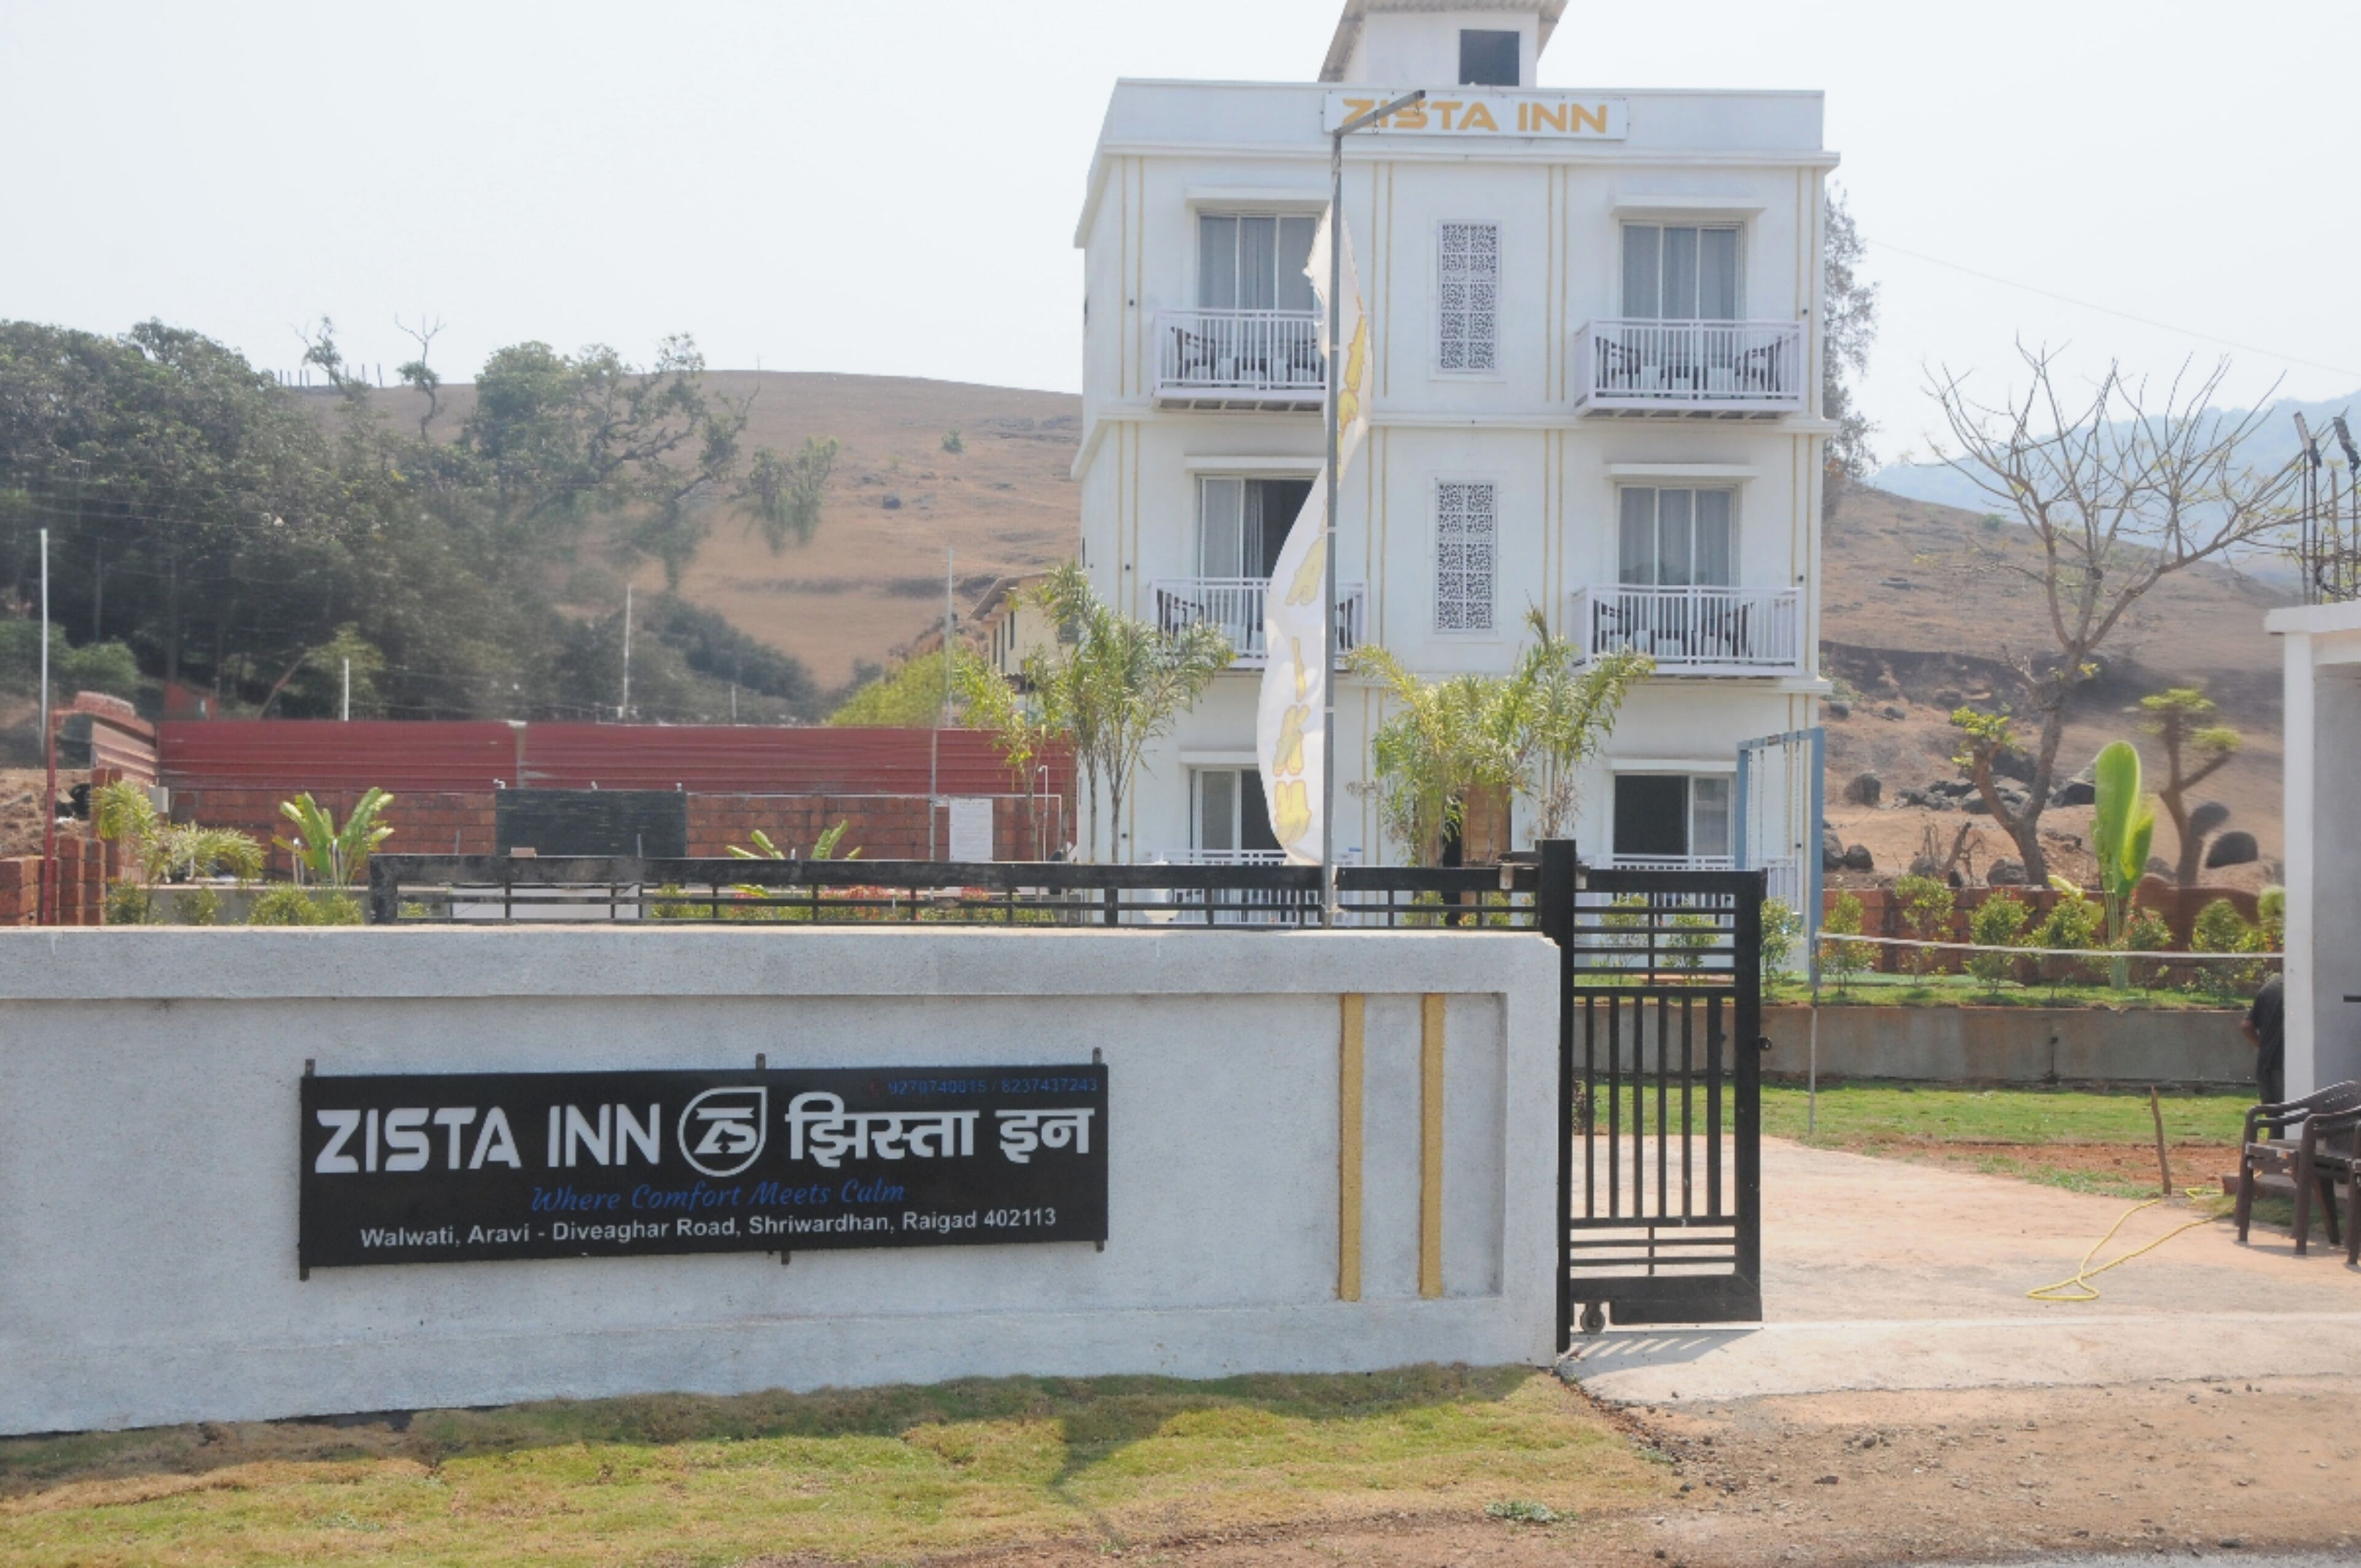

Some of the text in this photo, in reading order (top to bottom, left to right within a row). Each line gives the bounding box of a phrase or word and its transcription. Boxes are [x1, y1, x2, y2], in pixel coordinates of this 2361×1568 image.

[1342, 98, 1607, 134] ZISTA INN
[314, 1103, 660, 1173] ZISTA INN
[785, 1091, 1095, 1168] झिस्ता इन
[531, 1177, 905, 1211] Where Comfort Meets Calm
[360, 1226, 461, 1248] Walwati,
[467, 1223, 530, 1245] Aravi
[553, 1221, 670, 1245] Diveaghar
[676, 1218, 742, 1237] Road,
[748, 1214, 895, 1235] Shriwardhan,
[902, 1210, 978, 1234] Raigad
[983, 1208, 1057, 1228] 402113
